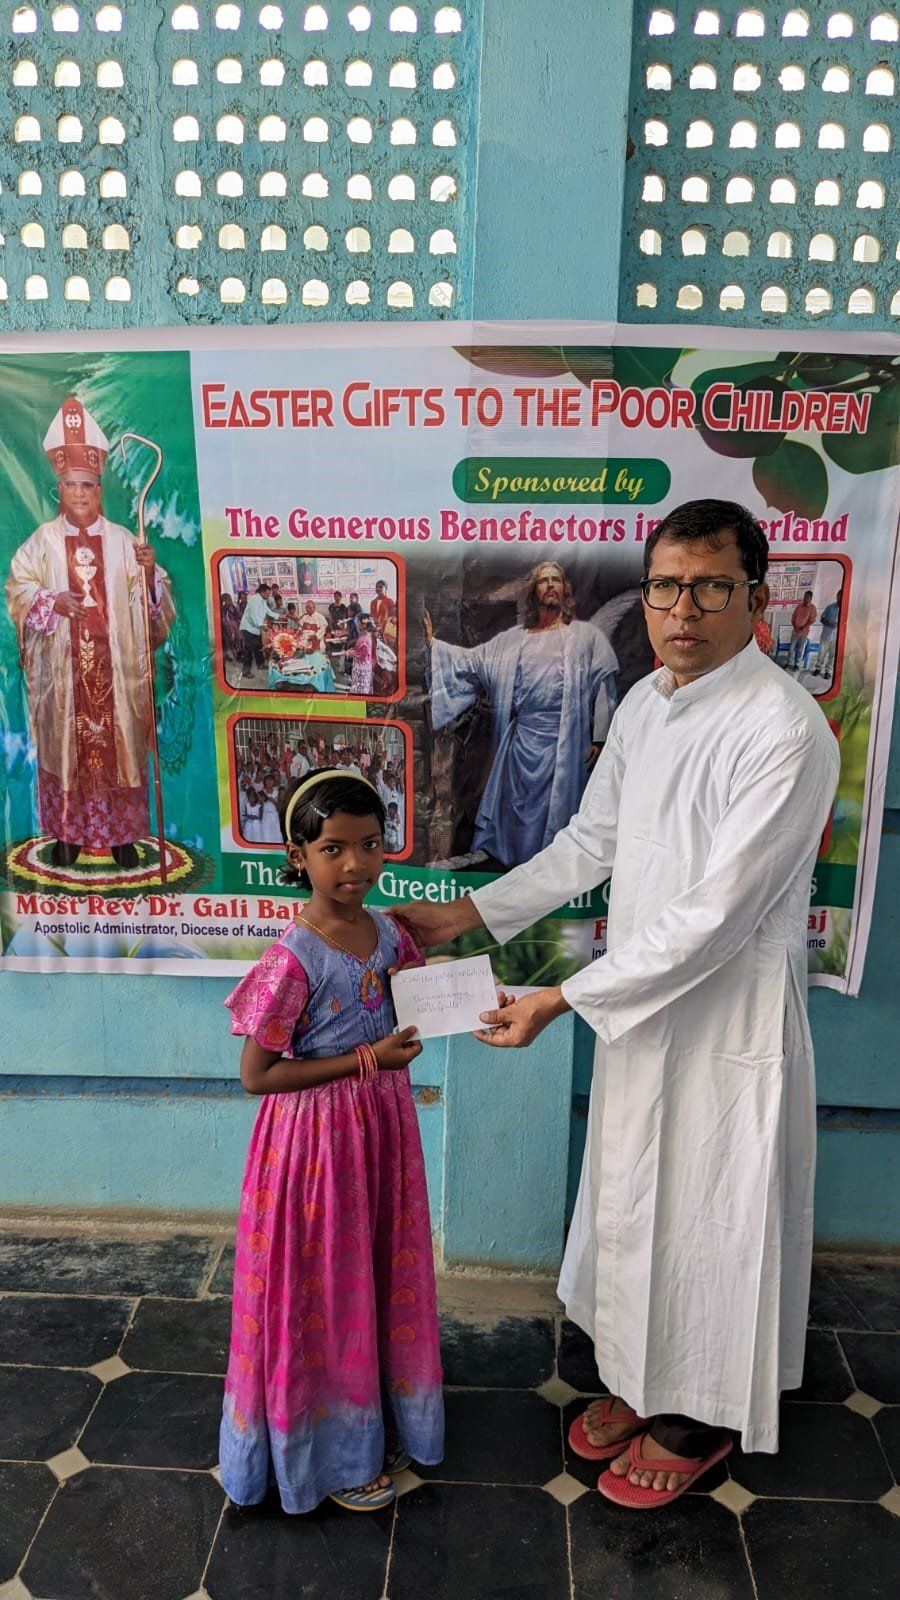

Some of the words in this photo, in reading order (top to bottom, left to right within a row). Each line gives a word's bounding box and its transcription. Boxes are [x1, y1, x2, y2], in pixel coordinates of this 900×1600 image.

[202, 383, 334, 428] EASTER
[343, 382, 446, 427] GIFTS
[454, 387, 503, 427] TO
[513, 388, 582, 427] THE
[591, 379, 695, 429] POOR
[702, 382, 872, 433] CHILDREN
[474, 467, 607, 499] Sponsored
[614, 468, 645, 501] by
[225, 507, 281, 538] The
[288, 508, 430, 541] Generous
[440, 510, 626, 542] Benefactors
[378, 871, 474, 904] Greetin
[16, 895, 79, 916] Most
[87, 896, 140, 917] Rev.
[148, 896, 185, 918] Dr.
[193, 897, 248, 919] Gali
[34, 920, 91, 936] Apostolic
[94, 921, 178, 938] Administrator,
[181, 922, 230, 937] Diocese
[232, 924, 245, 937] of
